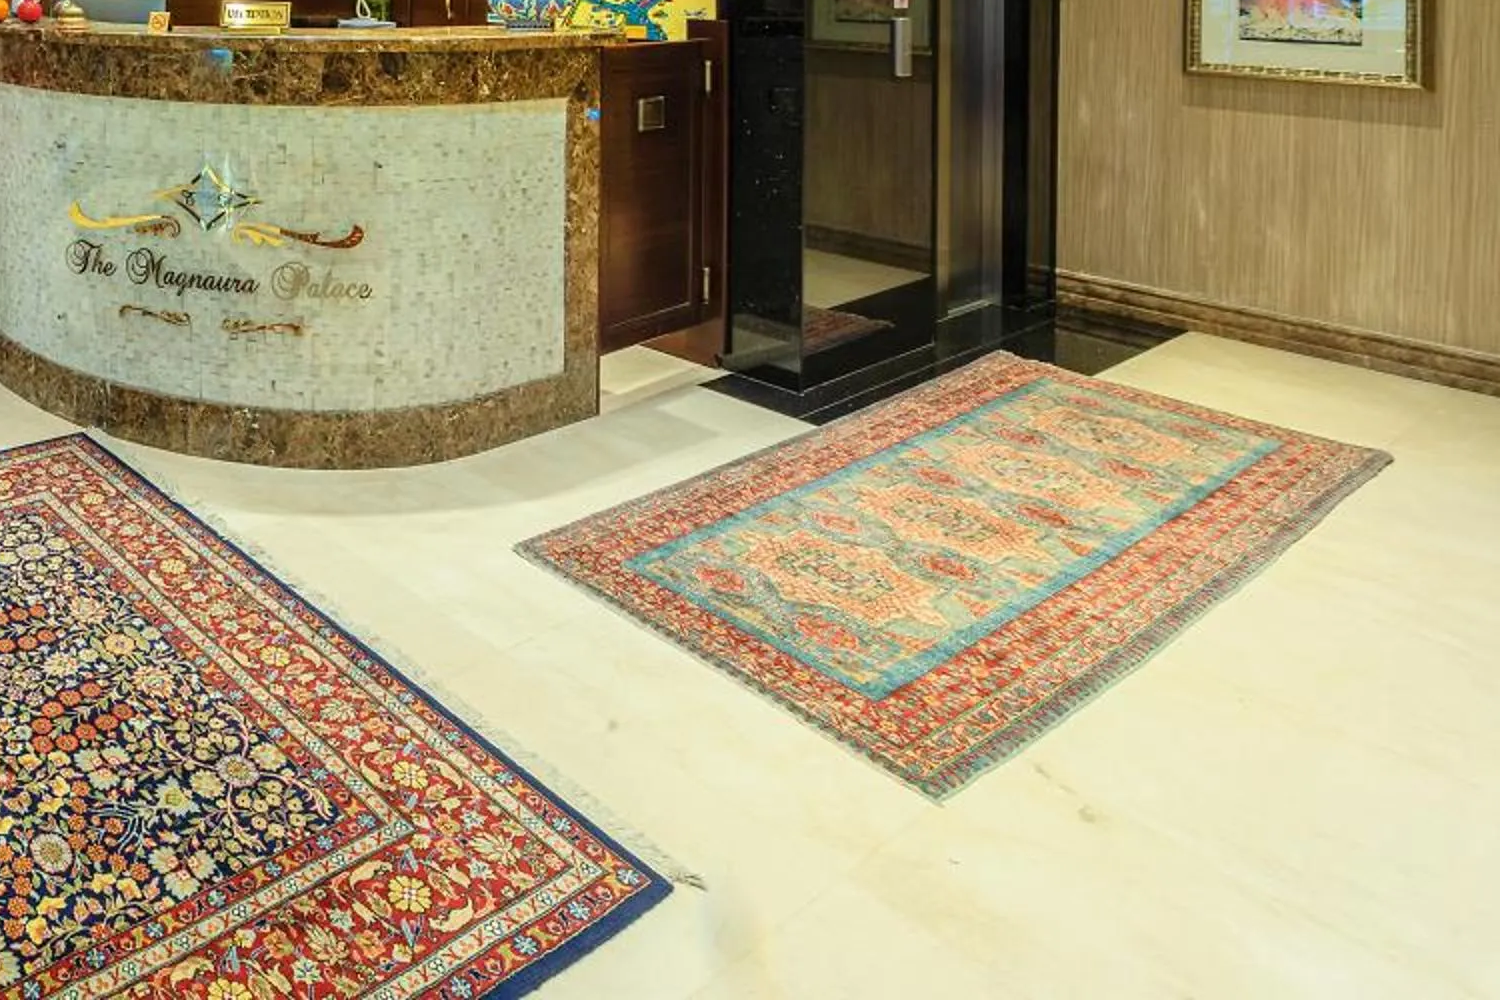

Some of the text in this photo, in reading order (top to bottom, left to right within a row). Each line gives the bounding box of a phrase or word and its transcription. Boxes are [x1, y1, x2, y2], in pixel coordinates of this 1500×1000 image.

[65, 239, 373, 300] The Magnaura Palace
